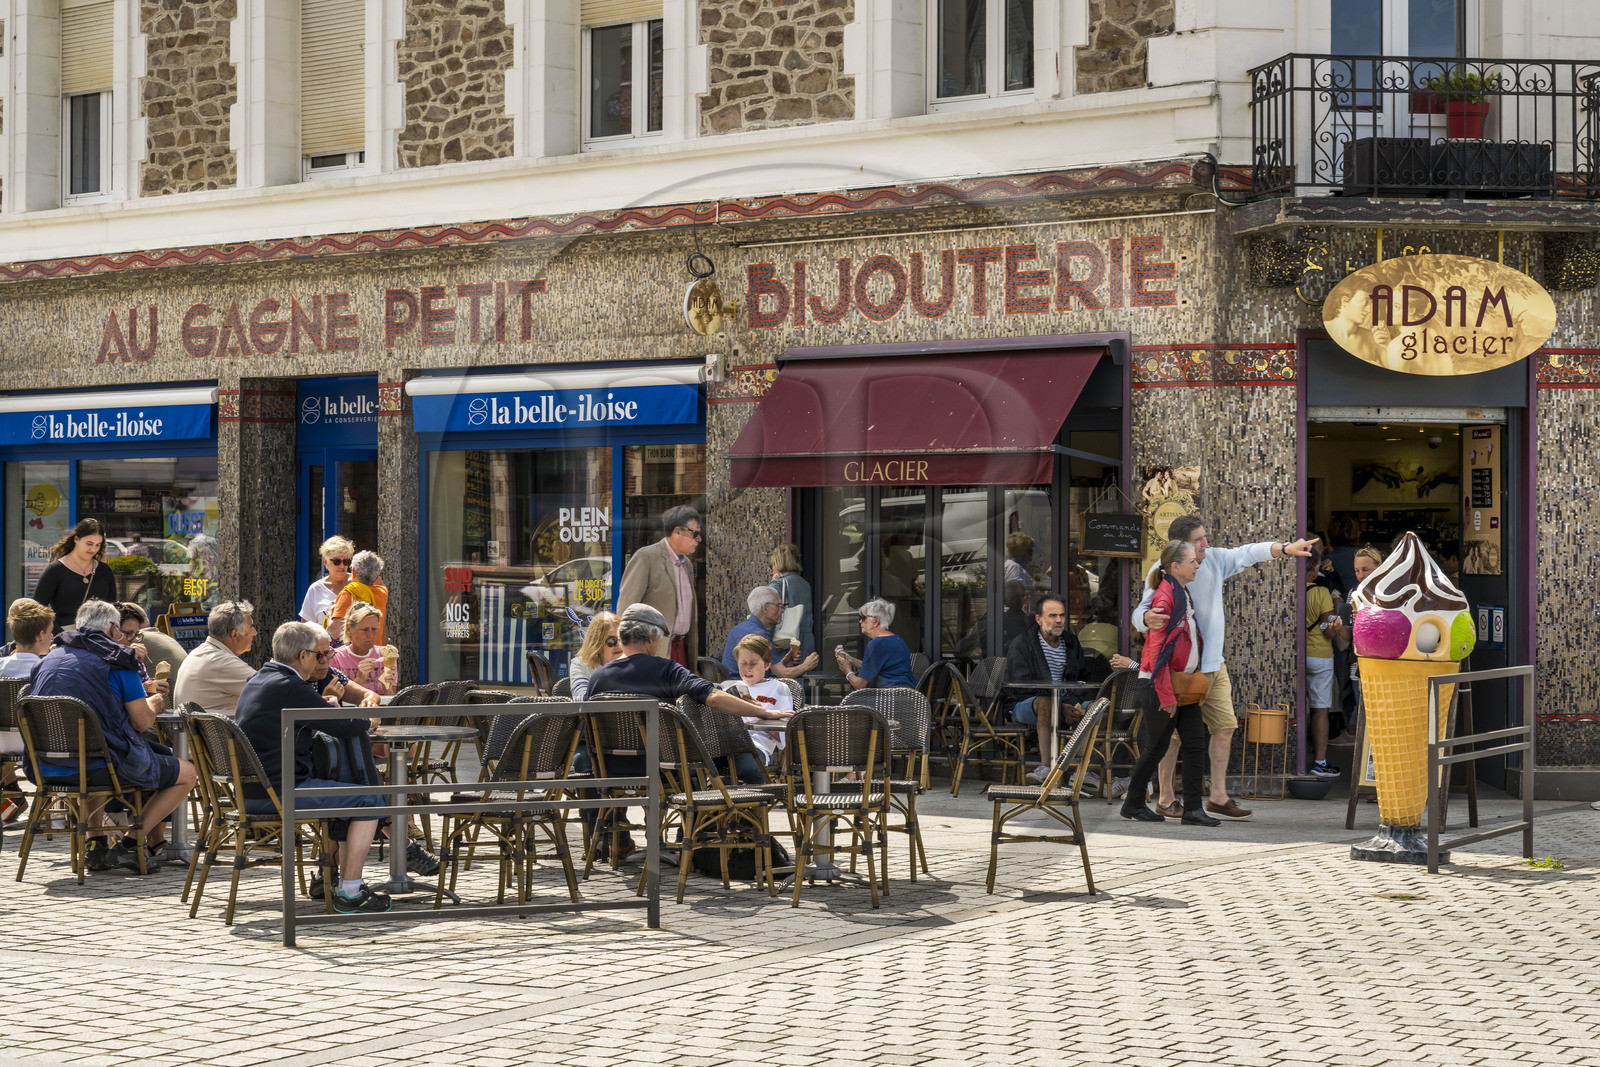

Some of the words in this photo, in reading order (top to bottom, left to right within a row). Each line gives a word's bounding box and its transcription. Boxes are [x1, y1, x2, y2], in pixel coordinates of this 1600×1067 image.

[748, 235, 1177, 330] BIJOUTERIE
[692, 296, 719, 310] ADAM
[1368, 284, 1514, 328] ADAM
[96, 306, 159, 364] AU
[181, 292, 360, 359] GAGNE
[385, 279, 546, 348] PETIT
[1401, 328, 1514, 361] glacier
[324, 396, 338, 415] la
[490, 396, 511, 426] la
[513, 392, 638, 425] belle-iloise
[49, 413, 64, 439] la
[66, 411, 163, 439] belle-iloise
[334, 416, 378, 424] CONSERVERIE
[647, 448, 660, 458] THON
[660, 447, 675, 458] BLANC
[844, 460, 929, 482] GLACIER
[168, 512, 206, 534] OUEST
[559, 506, 609, 527] PLEIN
[1088, 518, 1142, 533] Commande
[559, 526, 609, 543] OUEST
[444, 567, 472, 583] SUD
[573, 579, 584, 589] ON
[183, 578, 191, 596] SUD
[191, 578, 209, 596] EST
[444, 583, 472, 592] OUEST
[573, 588, 583, 601] LE
[585, 588, 604, 601] SUD
[446, 603, 470, 622] NOS
[446, 621, 470, 630] NOUVEAUX
[446, 629, 470, 639] COFFRETS
